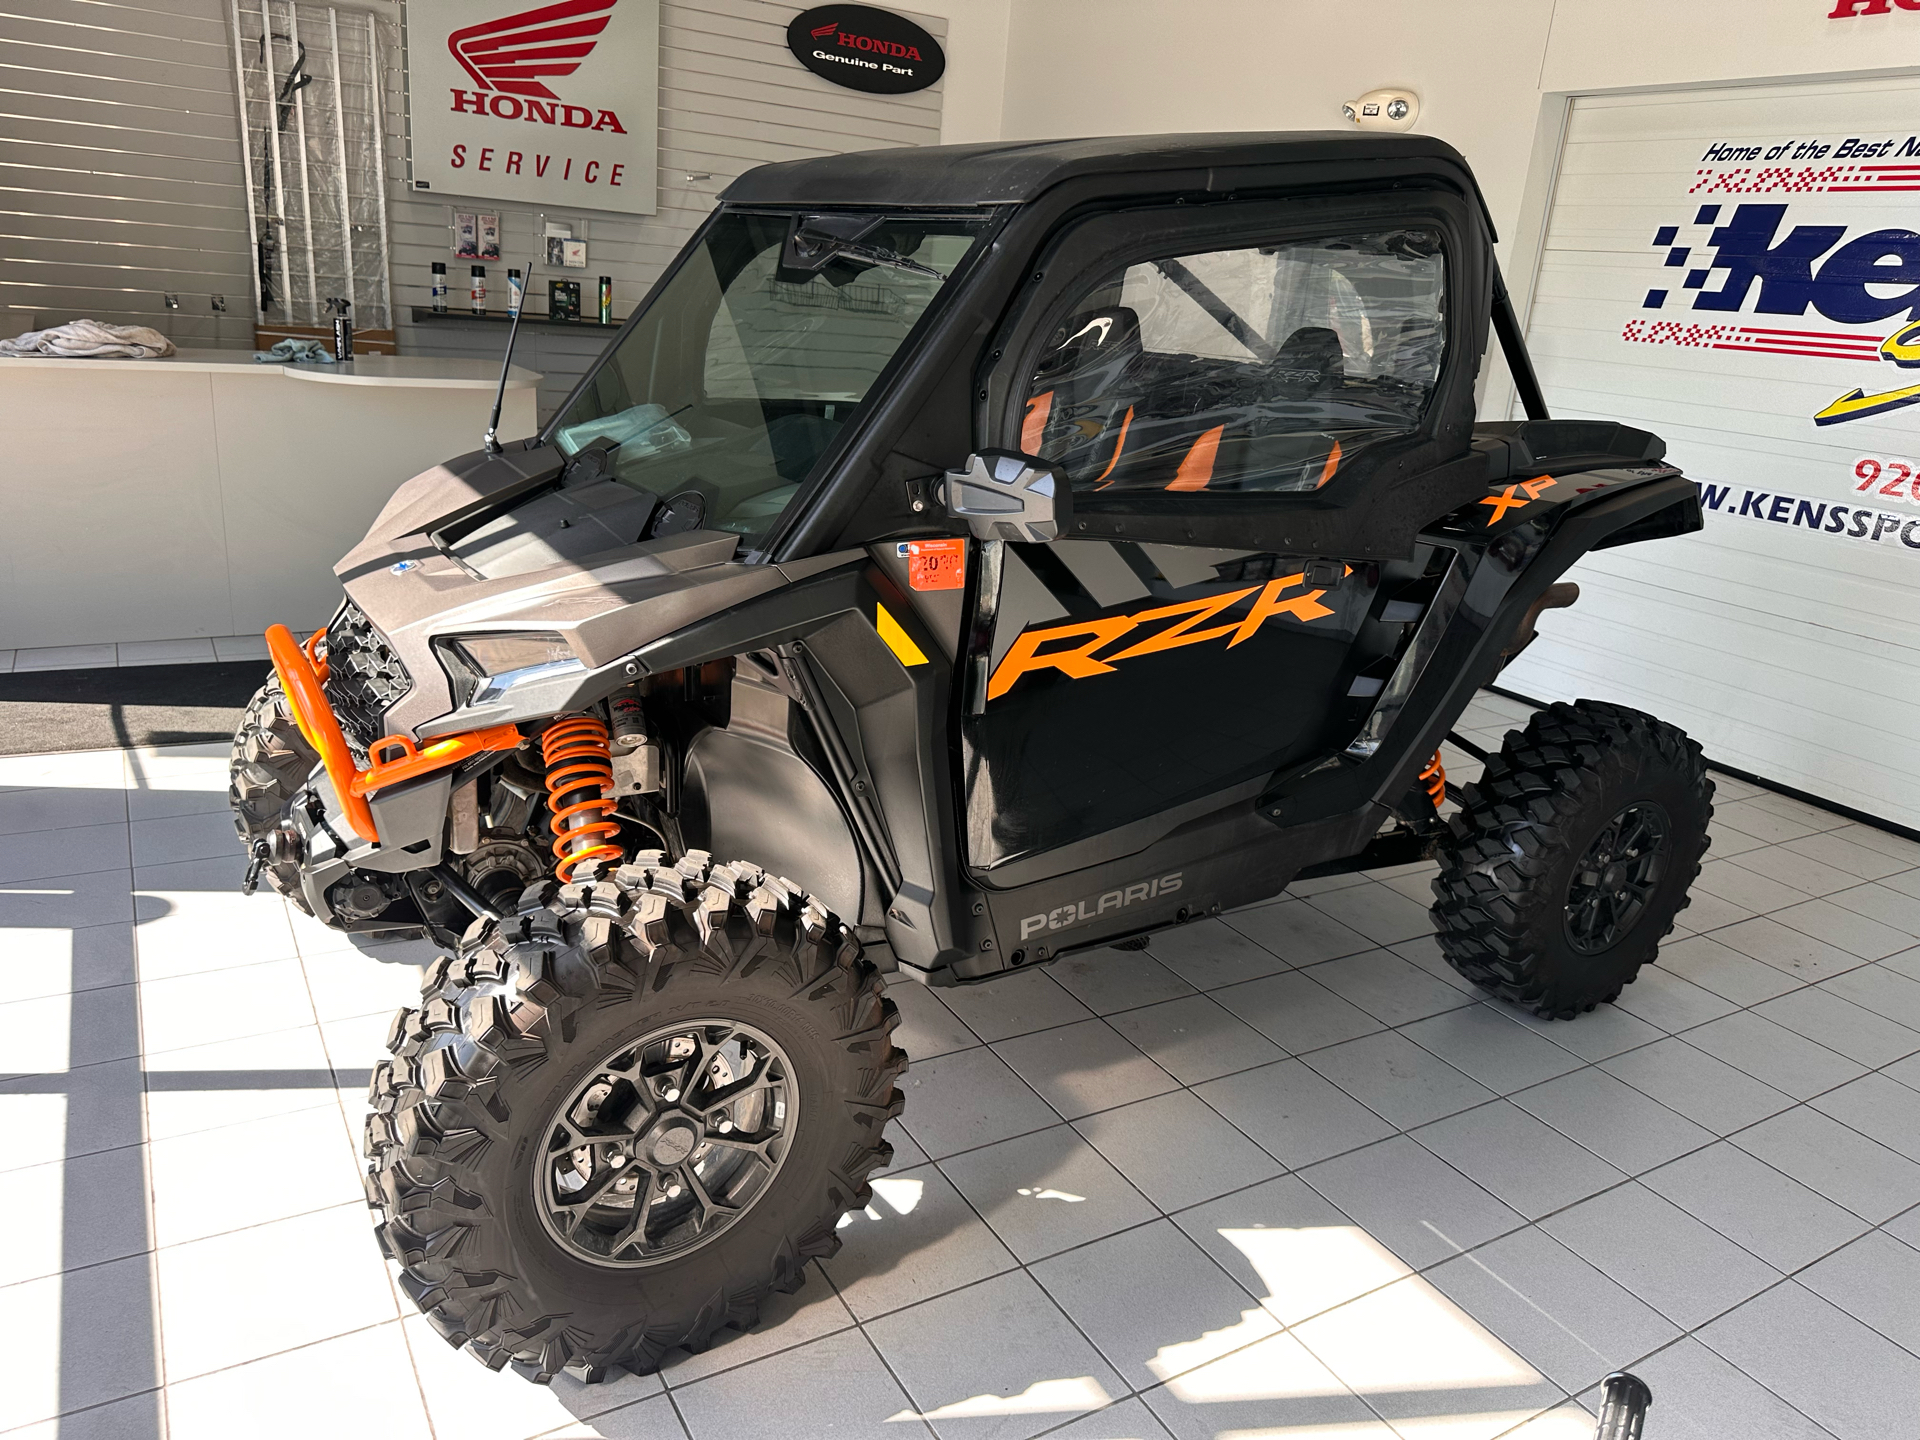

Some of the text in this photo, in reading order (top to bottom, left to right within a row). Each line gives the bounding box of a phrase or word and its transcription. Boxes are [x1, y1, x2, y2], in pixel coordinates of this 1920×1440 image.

[812, 50, 913, 76] Genuine Part
[837, 31, 922, 61] HONDA
[450, 88, 627, 134] HONDA
[451, 144, 624, 186] SERVICE
[1701, 142, 1762, 161] Home
[1764, 140, 1795, 160] of
[1791, 139, 1831, 159] the
[1832, 138, 1895, 158] Best
[1478, 474, 1558, 528] XP
[988, 564, 1354, 701] RZR
[1020, 871, 1183, 941] POLARIS
